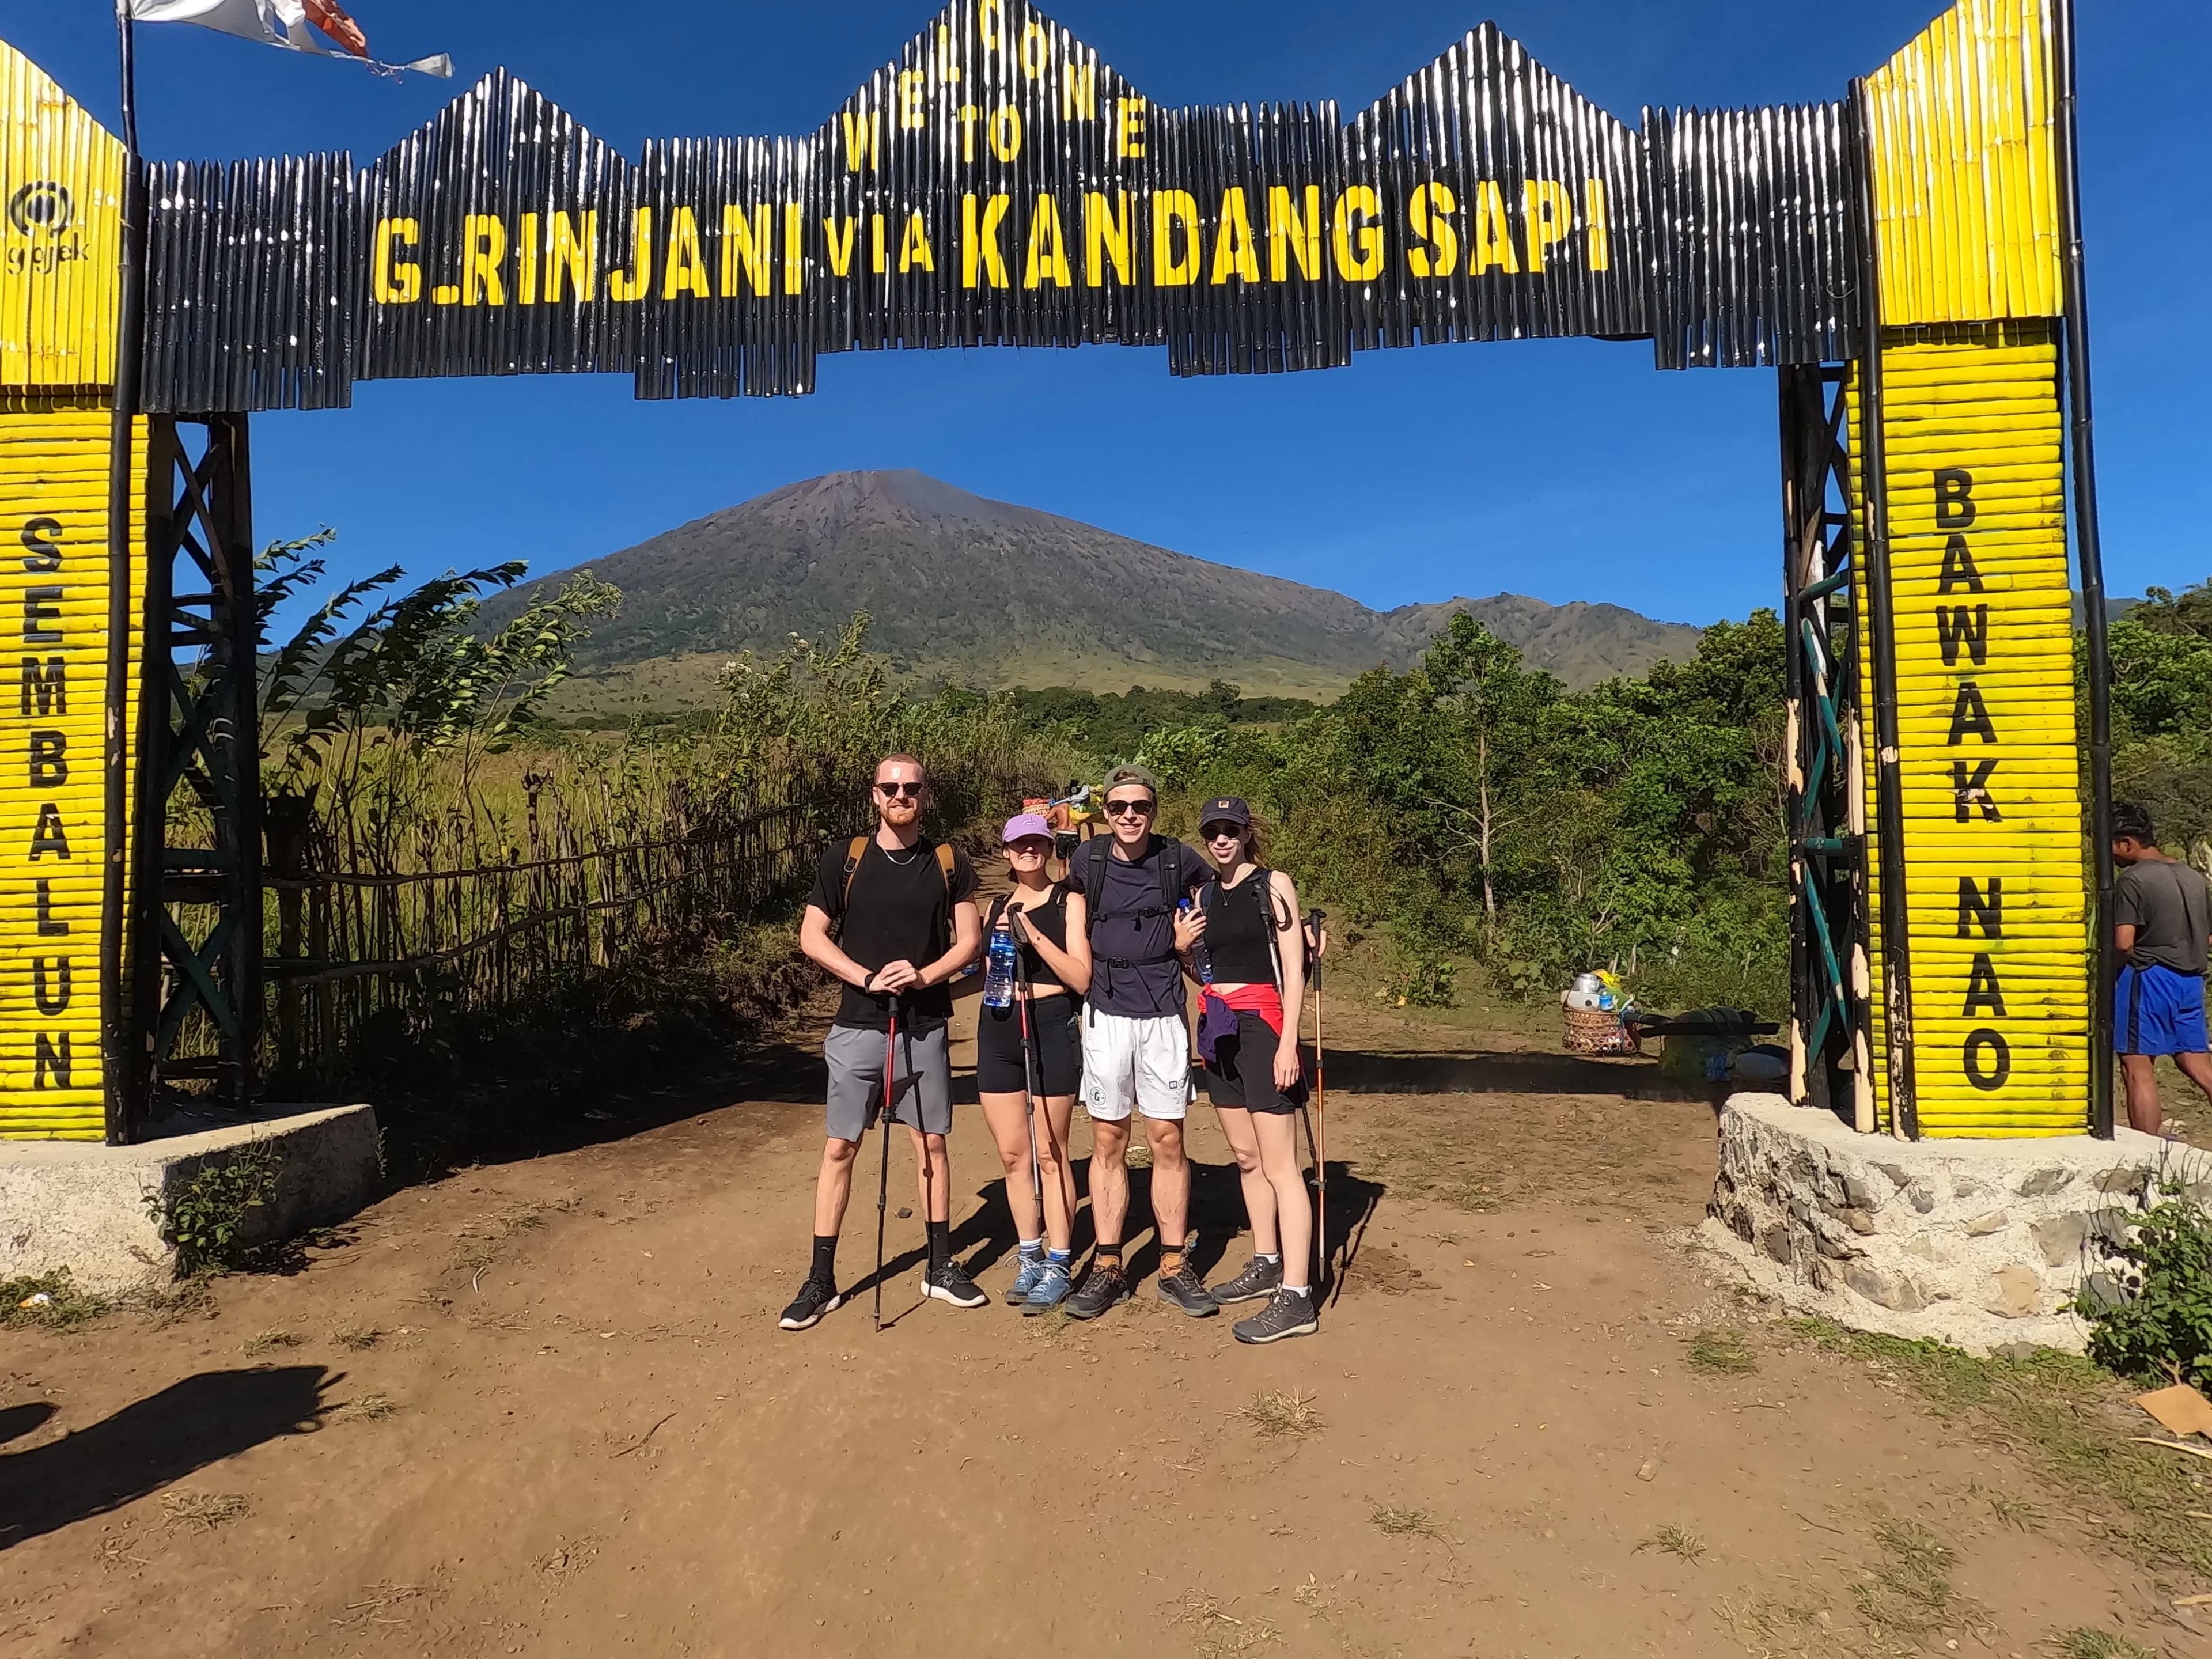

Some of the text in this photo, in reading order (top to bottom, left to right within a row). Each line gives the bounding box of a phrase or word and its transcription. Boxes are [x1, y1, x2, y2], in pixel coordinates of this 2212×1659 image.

[823, 213, 934, 277] VIA
[957, 104, 1021, 162] TO
[21, 517, 72, 1090] SEMBALUN
[1934, 469, 2010, 1092] BAWAK NAO
